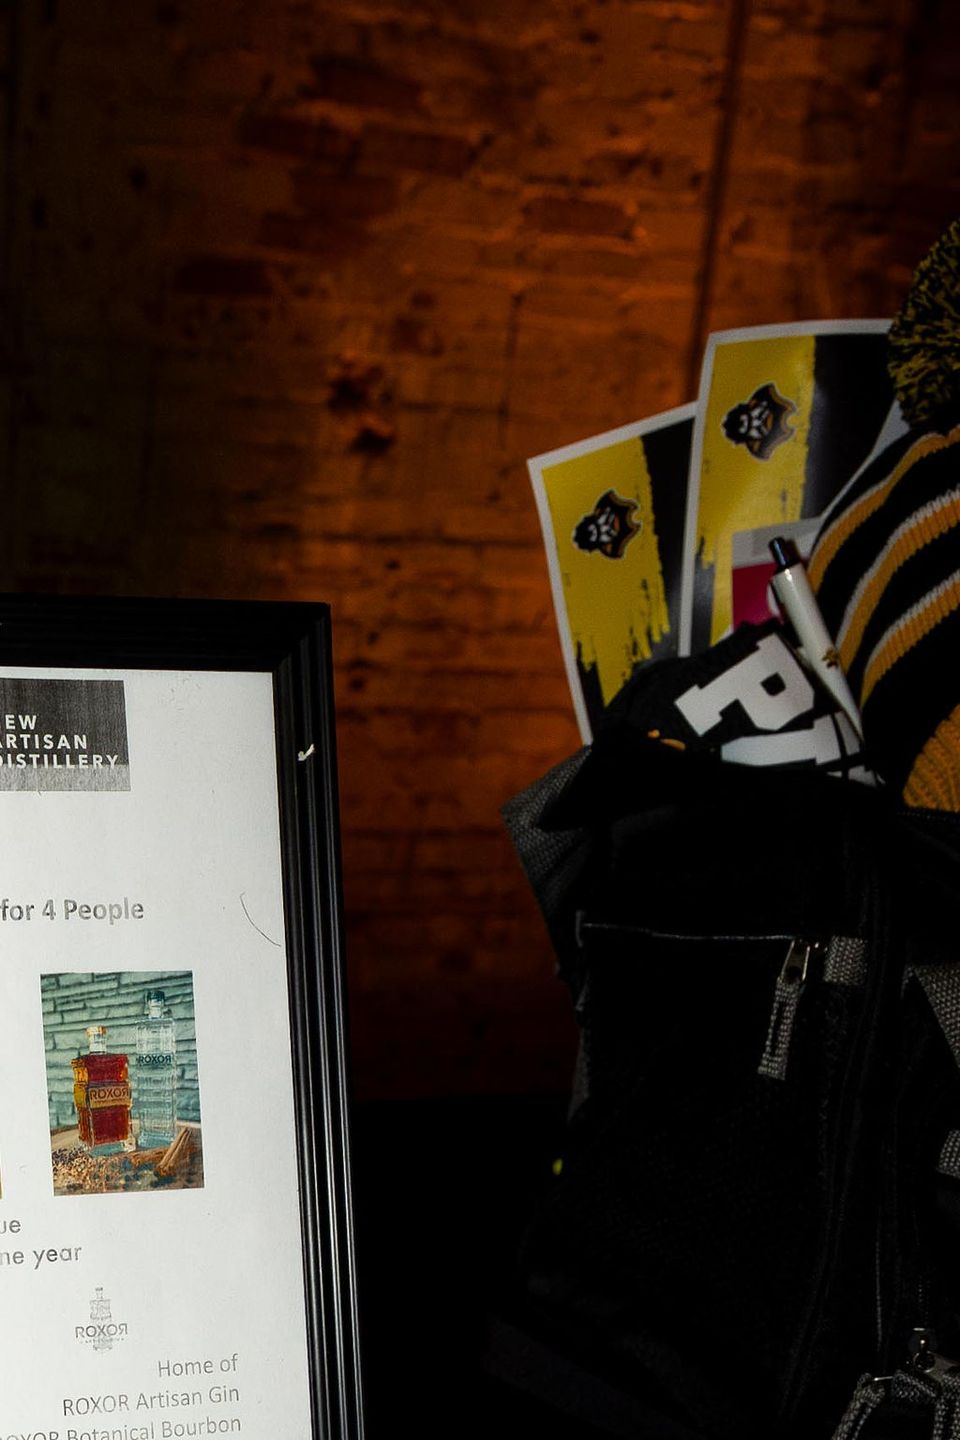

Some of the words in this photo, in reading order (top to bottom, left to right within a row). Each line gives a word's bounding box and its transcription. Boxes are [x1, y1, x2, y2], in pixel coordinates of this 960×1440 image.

[0, 898, 35, 922] for
[40, 898, 57, 921] 4
[63, 896, 145, 926] People
[32, 1245, 83, 1270] year
[158, 1358, 214, 1378] Home
[219, 1353, 240, 1373] of
[62, 1394, 130, 1417] ROXOR
[136, 1390, 203, 1411] Artisan
[208, 1385, 240, 1405] Gin
[161, 1415, 242, 1439] Bourbon
